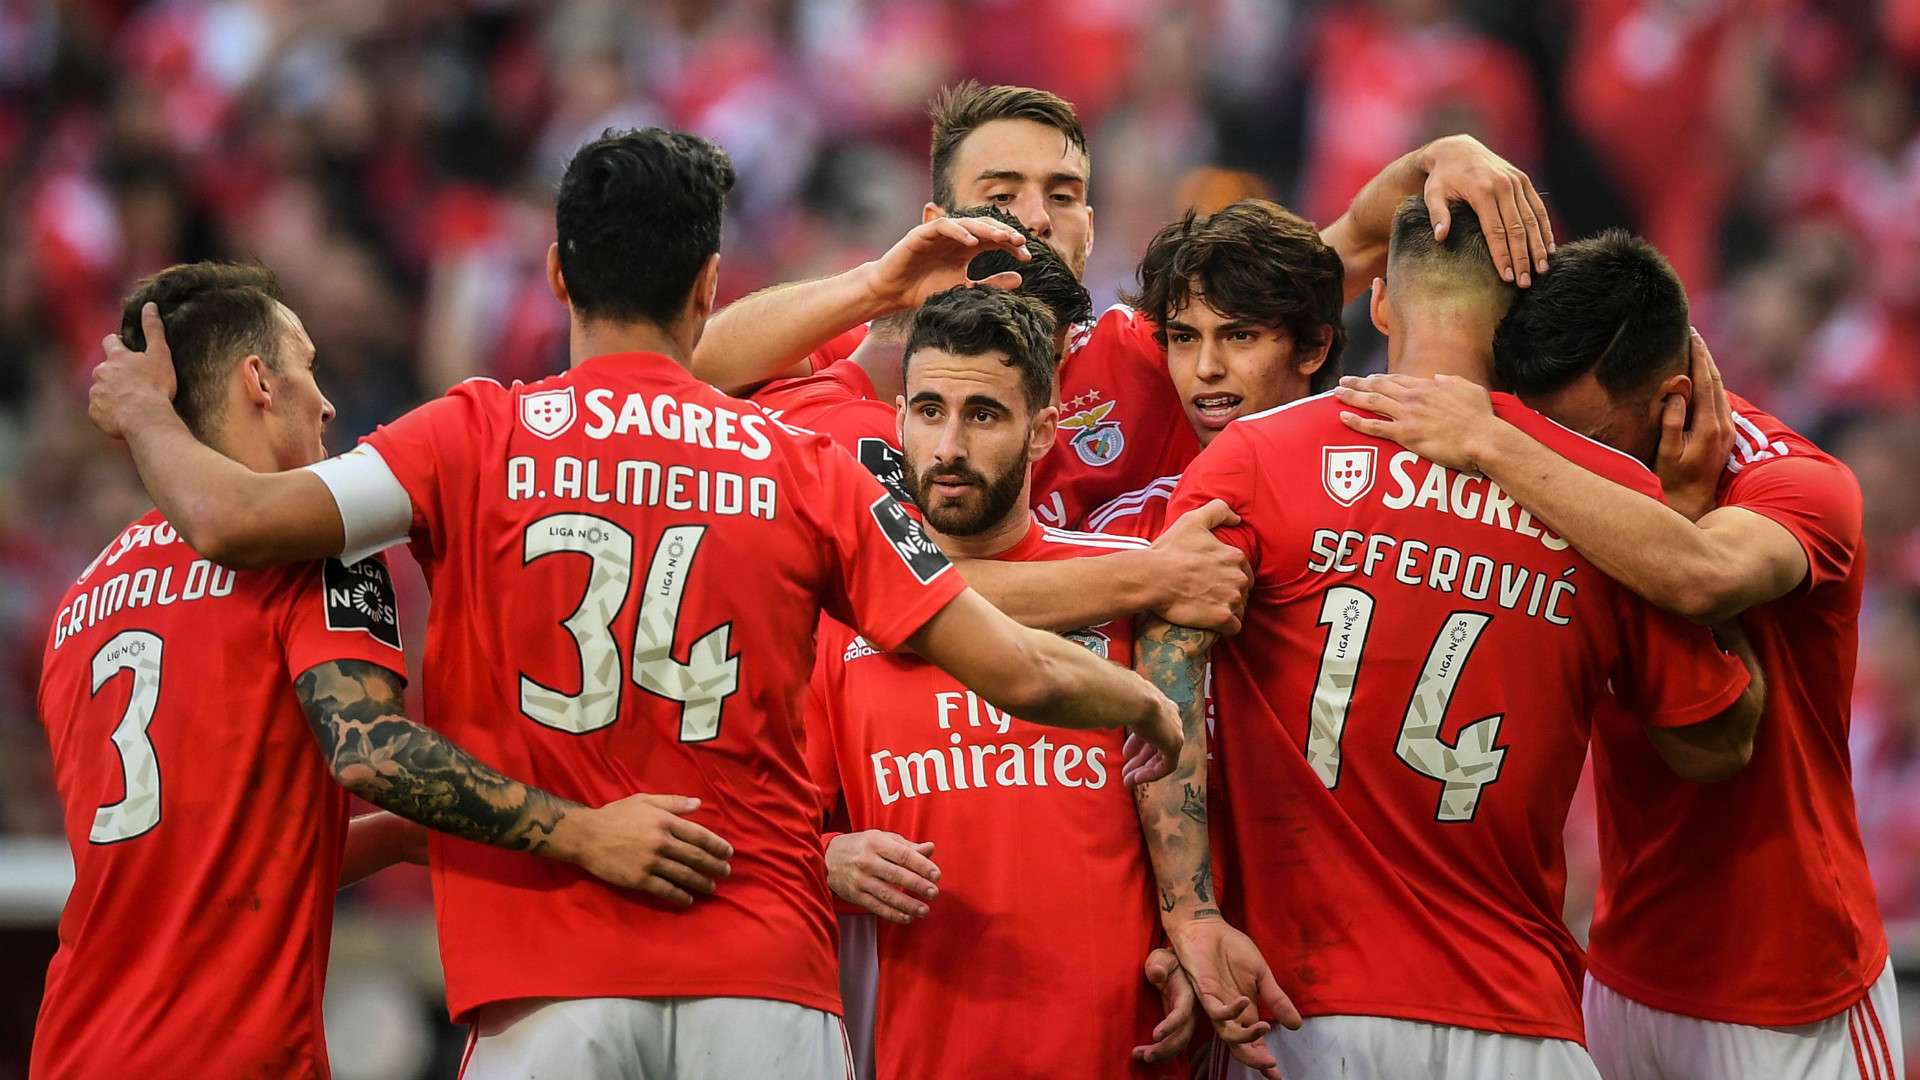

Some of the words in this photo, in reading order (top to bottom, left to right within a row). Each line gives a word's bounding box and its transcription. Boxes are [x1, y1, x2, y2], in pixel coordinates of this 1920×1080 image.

[584, 389, 772, 461] SAGRES
[507, 456, 777, 521] A.ALMEIDA
[105, 520, 185, 567] SAG
[549, 527, 574, 538] LIGA
[578, 527, 610, 544] NOS
[660, 569, 674, 596] LIGA
[668, 535, 684, 568] NOS
[53, 558, 237, 651] GRIMALDO
[329, 580, 395, 625] NOS
[348, 561, 384, 585] LIGA
[1307, 527, 1577, 626] SEFEROVIĆ
[518, 512, 741, 744] 34
[1336, 633, 1350, 659] LIGA
[1343, 598, 1360, 631] NOS
[1437, 652, 1455, 679] LIGA
[1450, 619, 1468, 652] NOS
[935, 690, 1012, 734] Fly
[1306, 584, 1510, 825] 14
[88, 628, 165, 845] 3
[871, 732, 1107, 806] Emirates
